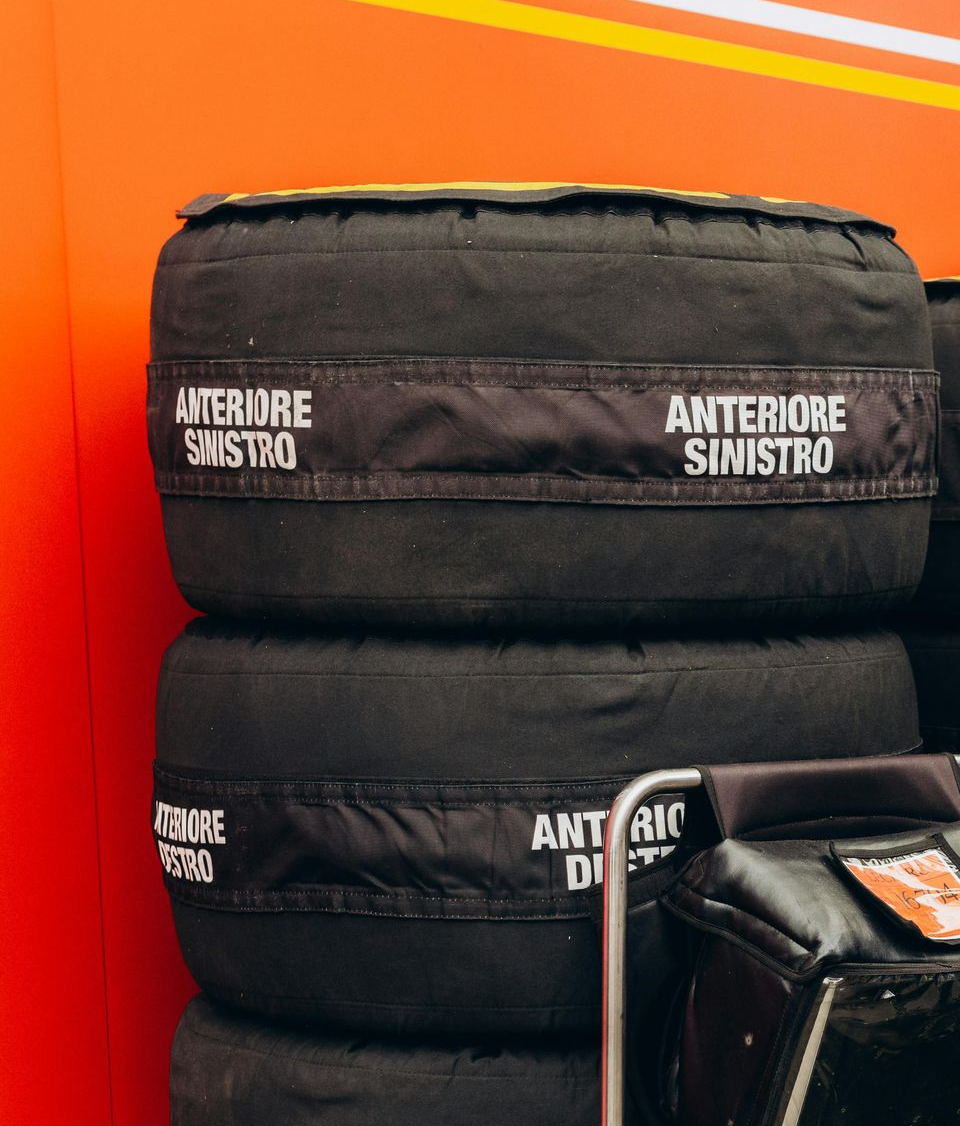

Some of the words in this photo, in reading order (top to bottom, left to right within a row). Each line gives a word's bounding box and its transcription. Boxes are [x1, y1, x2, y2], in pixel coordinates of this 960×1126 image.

[175, 387, 312, 428] ANTERIORE
[664, 394, 846, 433] ANTERIORE
[184, 428, 297, 470] SINISTRO
[684, 436, 834, 475] SINISTRO
